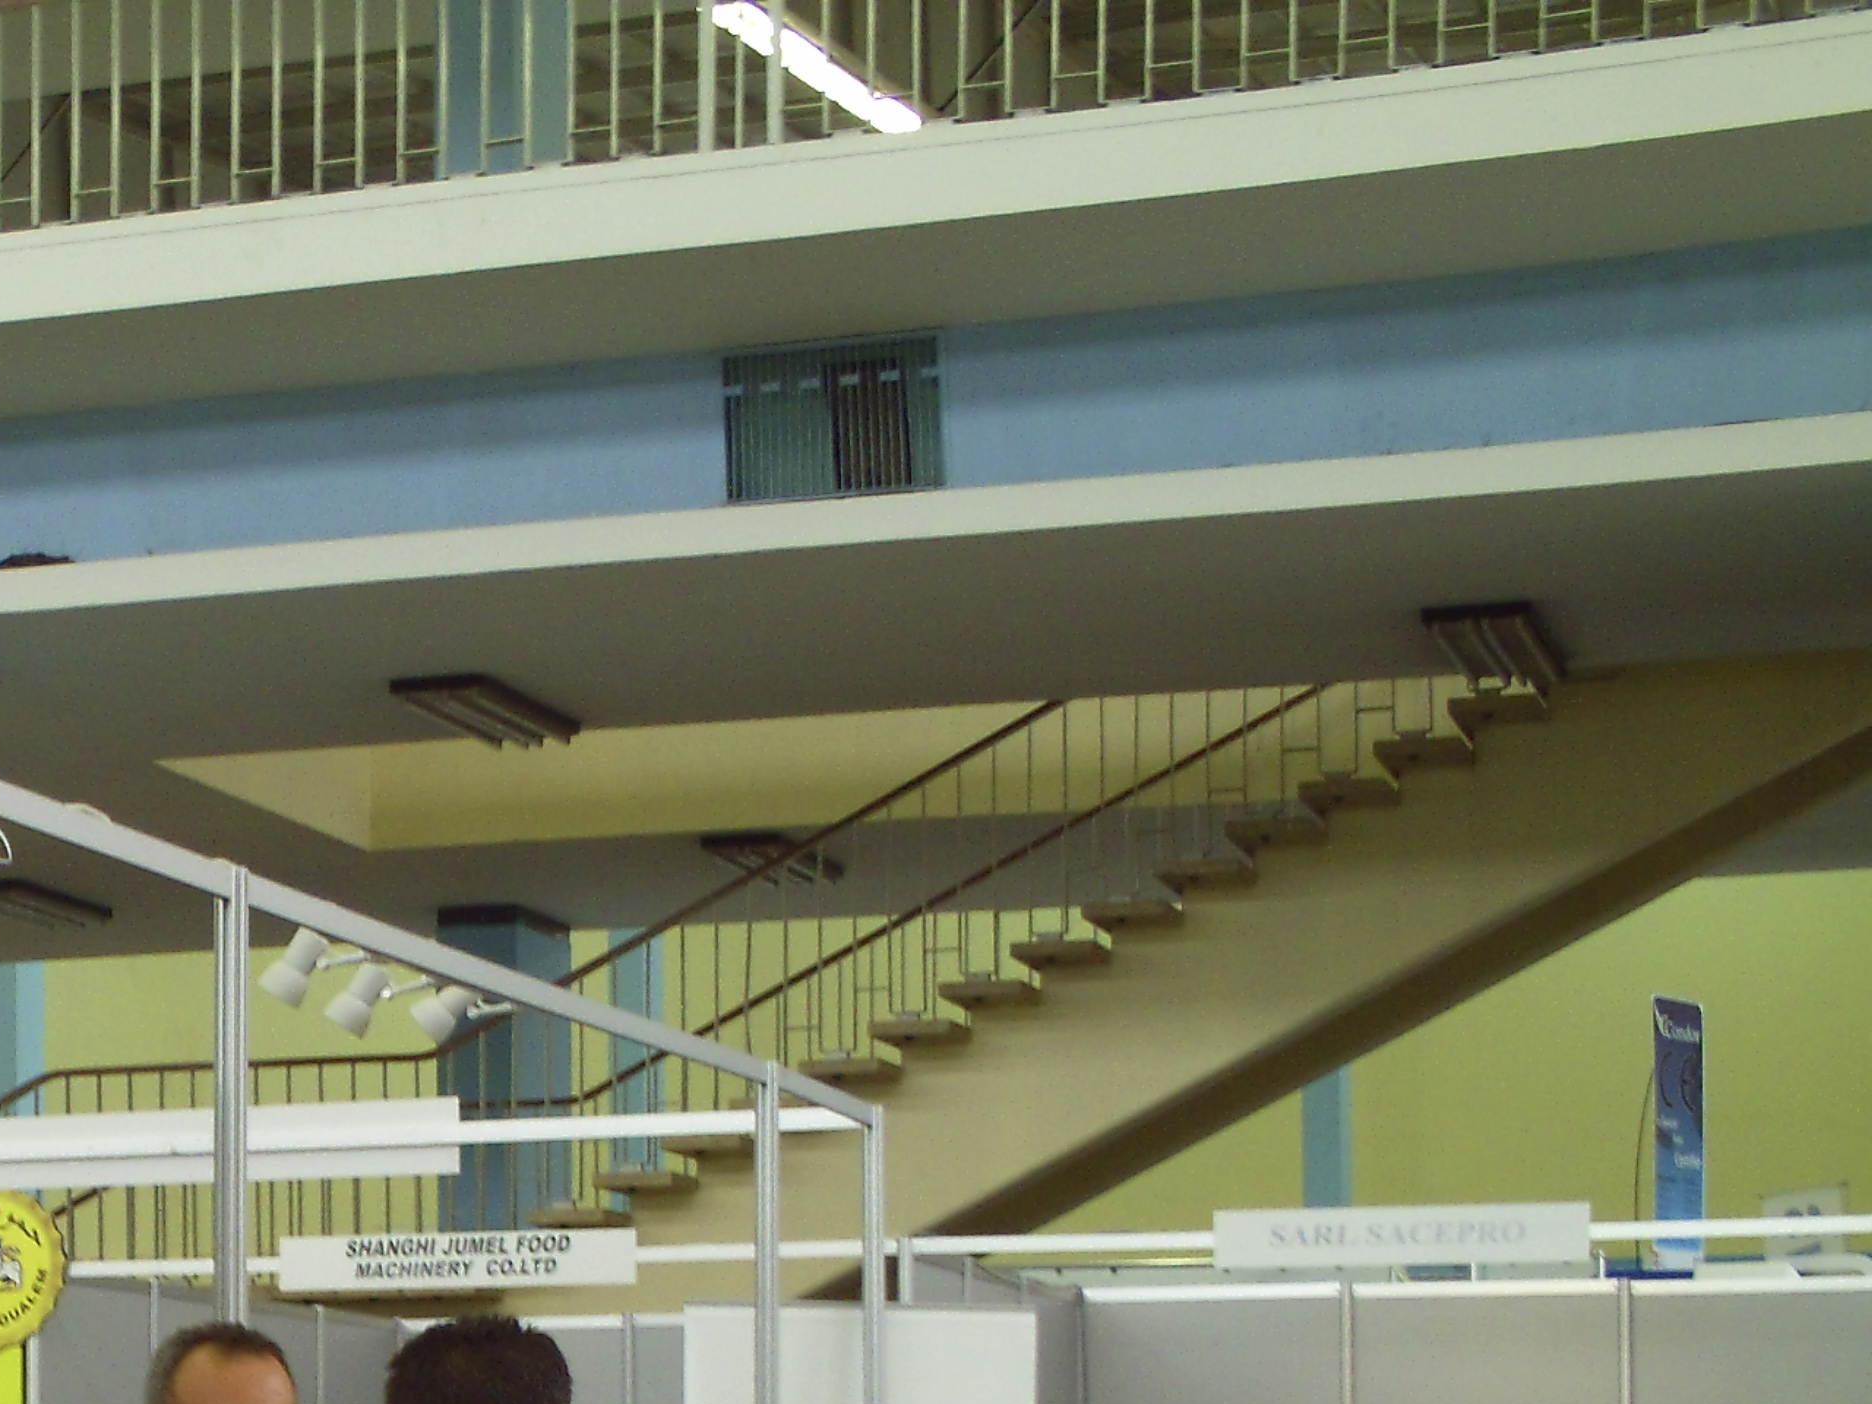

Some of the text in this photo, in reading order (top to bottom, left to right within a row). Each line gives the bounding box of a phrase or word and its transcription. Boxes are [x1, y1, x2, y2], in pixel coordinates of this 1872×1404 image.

[345, 1233, 571, 1258] SHANGHI JUMEL FOOD
[1268, 1222, 1357, 1247] SARL
[354, 1259, 473, 1280] MACHINERY
